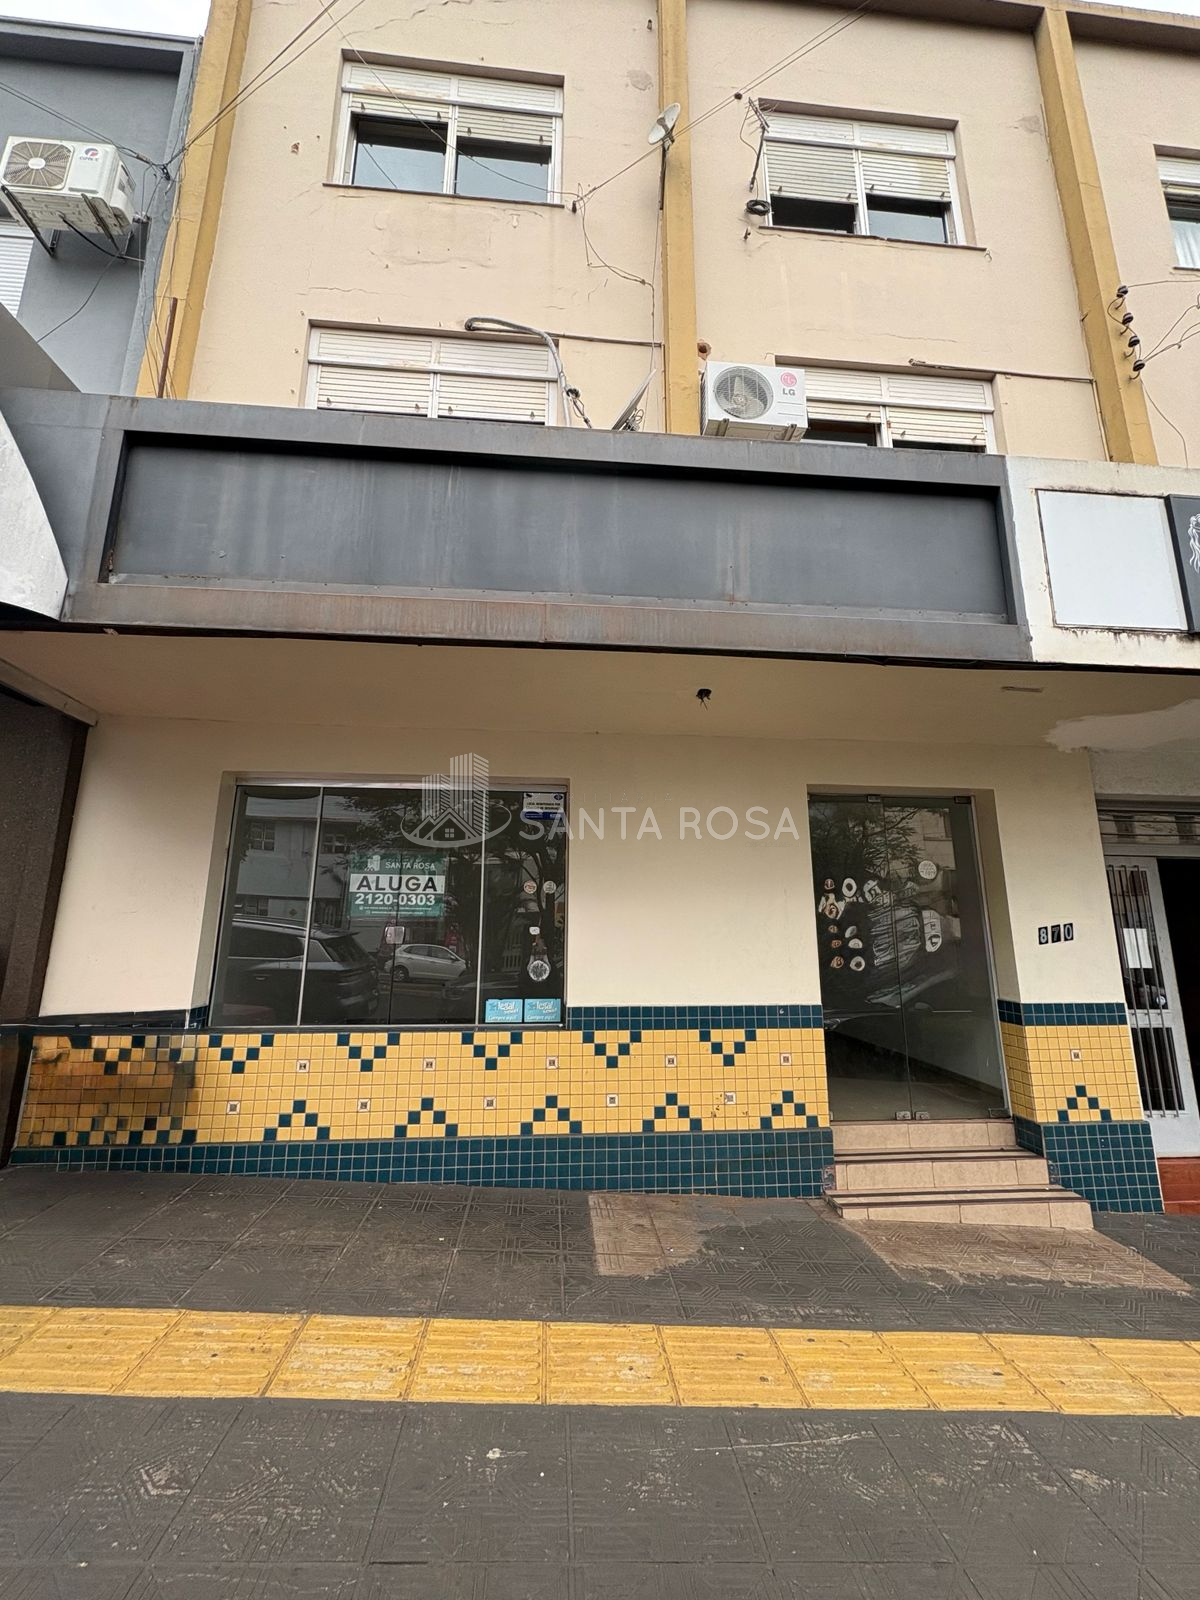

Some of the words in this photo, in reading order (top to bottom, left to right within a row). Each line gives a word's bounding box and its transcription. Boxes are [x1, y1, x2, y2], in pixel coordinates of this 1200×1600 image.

[782, 387, 796, 396] LG
[413, 861, 436, 870] ROSA
[356, 875, 437, 892] ALUGA
[354, 893, 436, 905] 2120-0303
[1039, 924, 1073, 943] 870
